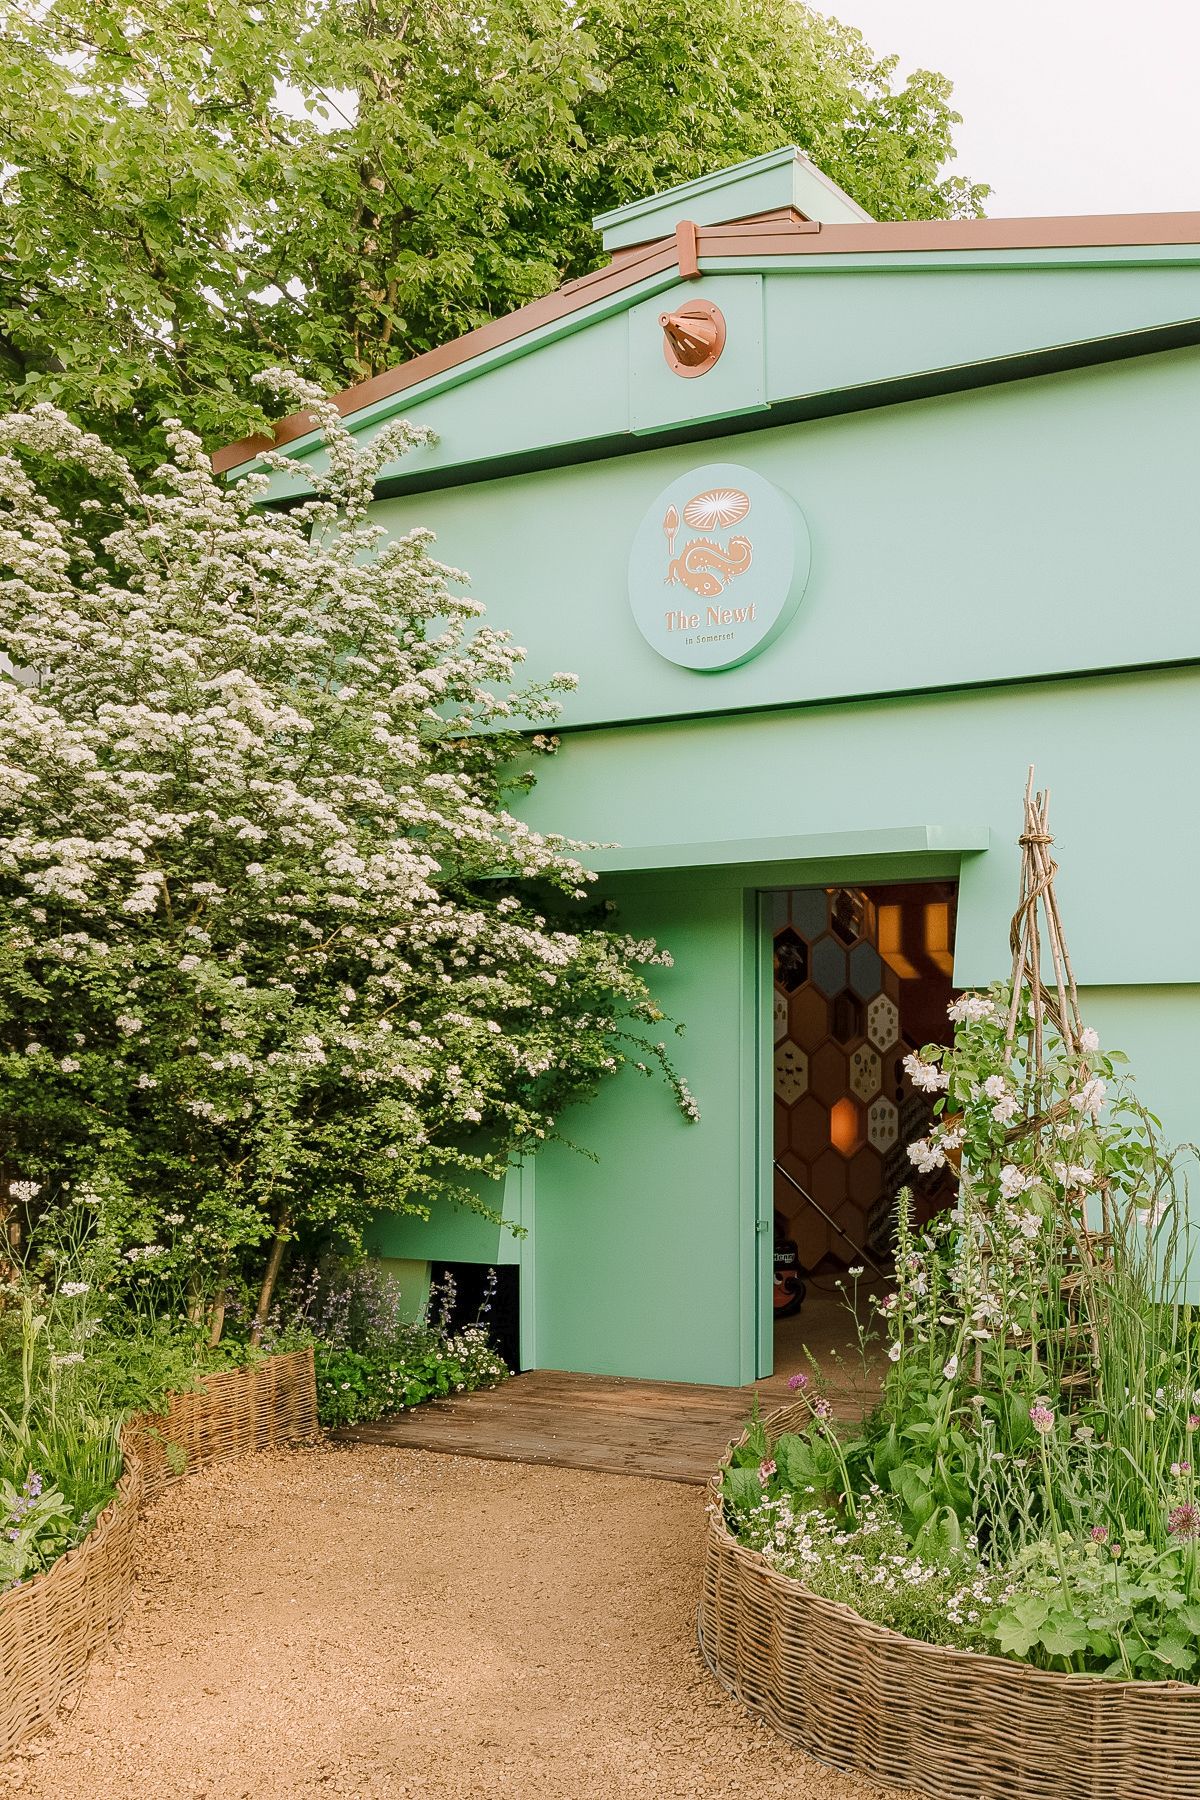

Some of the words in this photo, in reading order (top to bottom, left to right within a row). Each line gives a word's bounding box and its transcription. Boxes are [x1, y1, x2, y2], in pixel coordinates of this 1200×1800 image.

[665, 610, 700, 632] The
[706, 603, 756, 627] Newt
[685, 637, 693, 645] in
[696, 632, 735, 644] Somerset
